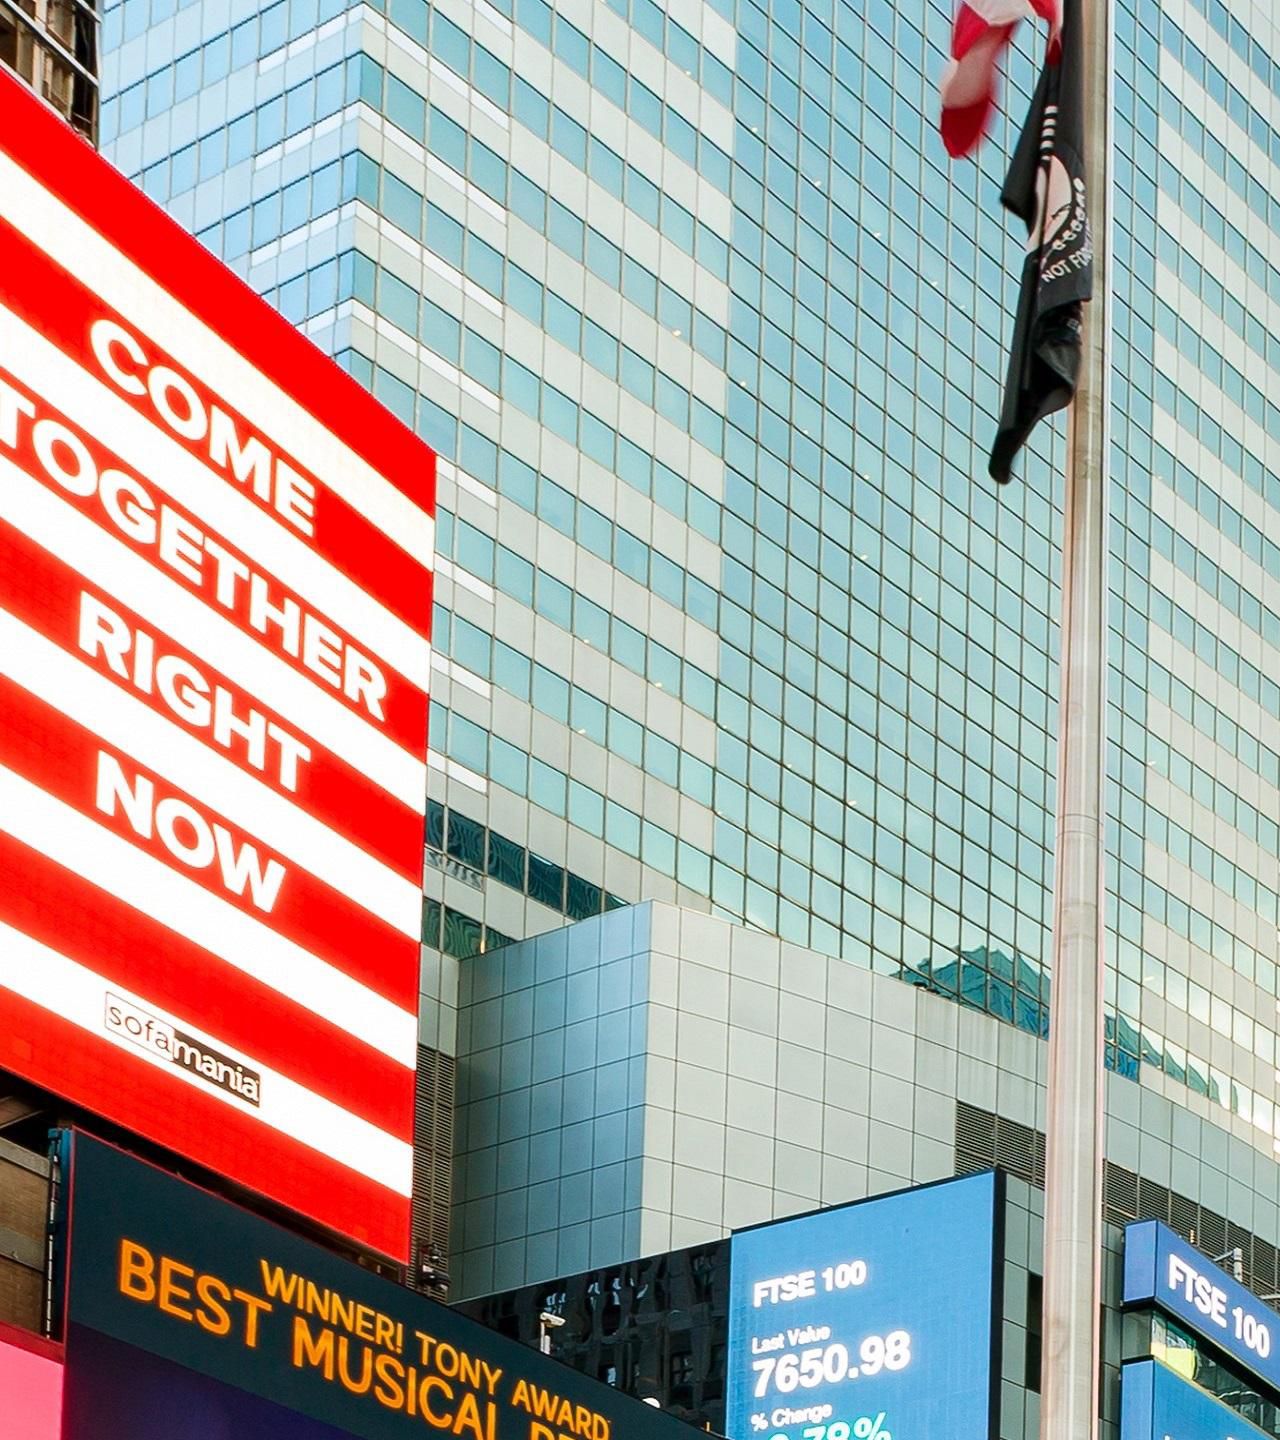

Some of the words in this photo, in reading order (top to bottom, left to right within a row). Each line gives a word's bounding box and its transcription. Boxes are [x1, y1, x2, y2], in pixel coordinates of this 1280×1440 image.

[1041, 259, 1072, 283] NOT
[89, 318, 316, 538] COME
[0, 384, 387, 723] TOGETHER
[78, 588, 311, 794] RIGHT
[96, 749, 286, 913] NOW
[109, 1006, 260, 1102] sofamania
[118, 1237, 272, 1349] BEST
[260, 1259, 404, 1350] WINNER!
[415, 1331, 502, 1397] TONY
[753, 1272, 816, 1307] FTSE
[821, 1260, 867, 1292] 100
[1168, 1254, 1228, 1326] FTSE
[1231, 1307, 1270, 1359] 100
[751, 1331, 911, 1397] 7650.98
[752, 1331, 783, 1355] Last
[787, 1324, 830, 1348] Value
[751, 1414, 768, 1431] %
[772, 1403, 832, 1428] Change
